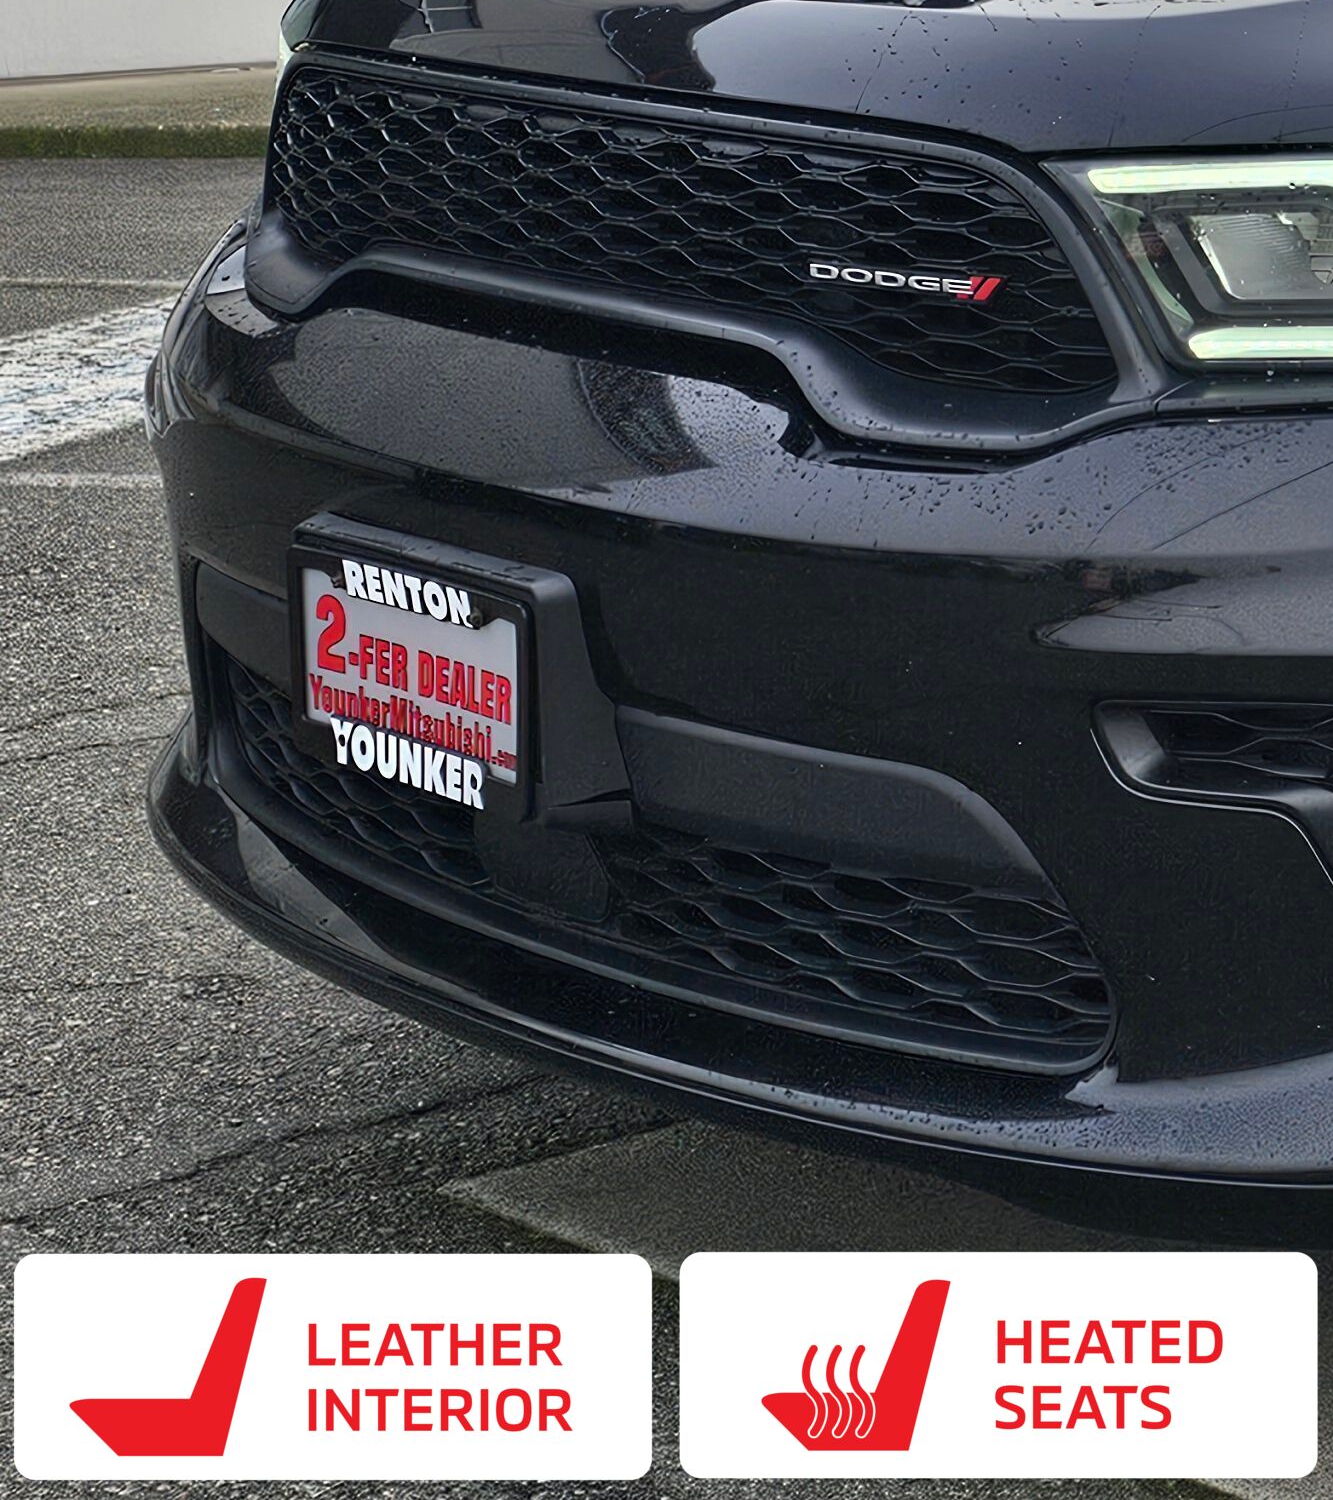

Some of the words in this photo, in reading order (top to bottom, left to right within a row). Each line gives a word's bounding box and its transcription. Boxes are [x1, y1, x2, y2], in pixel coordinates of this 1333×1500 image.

[809, 263, 974, 295] DODGE
[341, 559, 474, 629] RENTON
[315, 593, 409, 692] 2-FER
[417, 649, 513, 726] DEALER
[329, 715, 484, 811] YOUNKER
